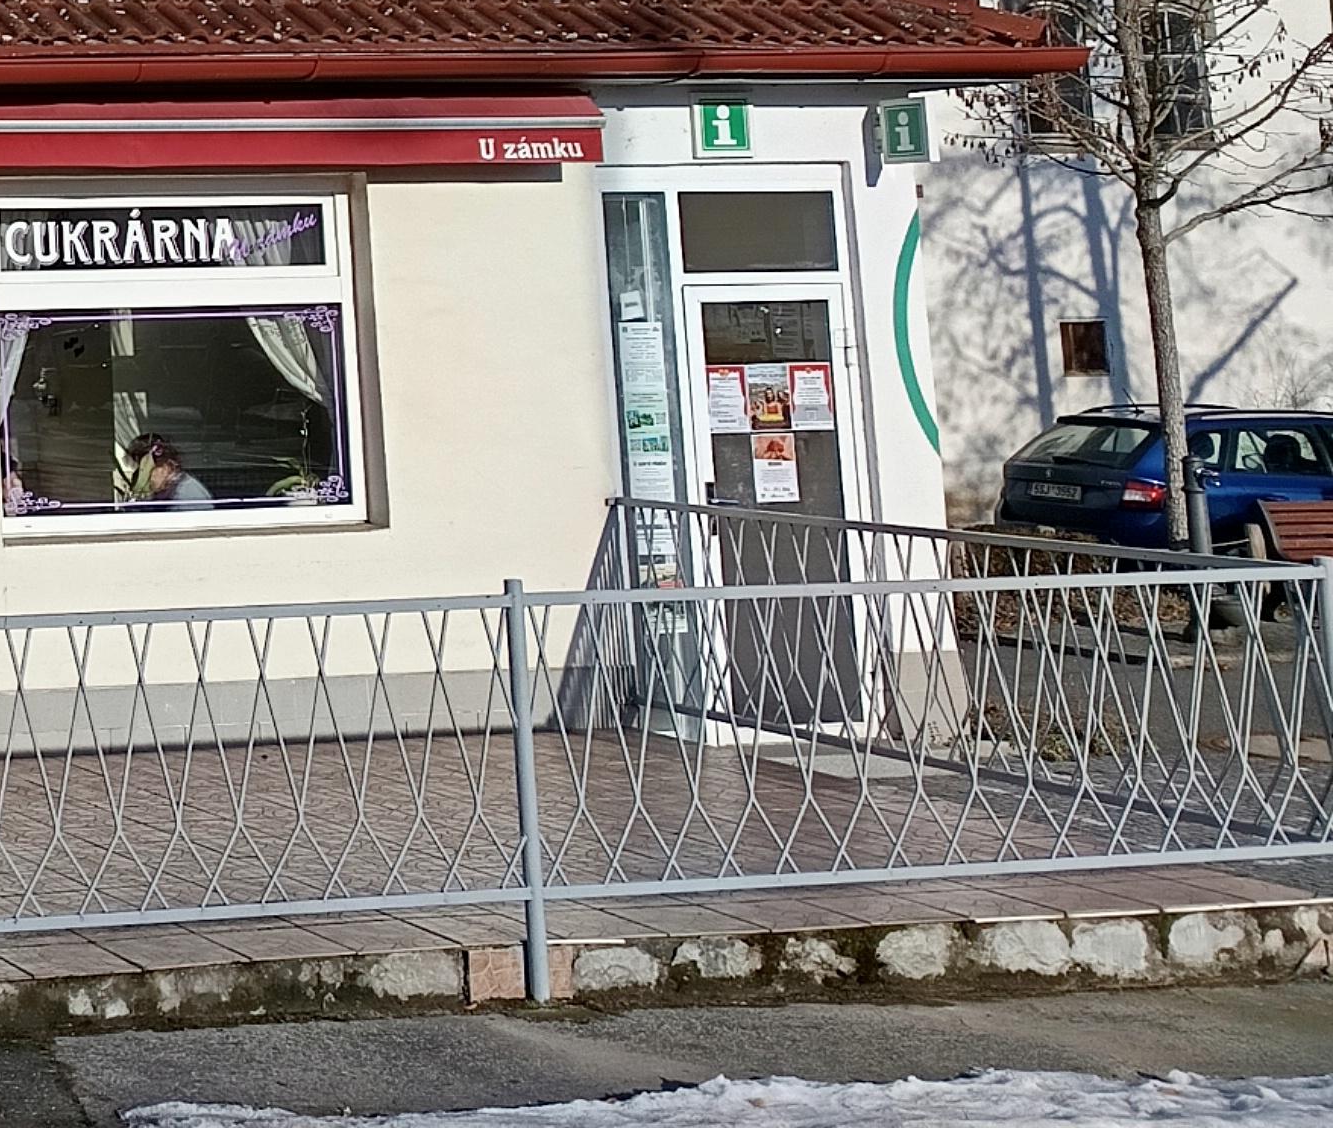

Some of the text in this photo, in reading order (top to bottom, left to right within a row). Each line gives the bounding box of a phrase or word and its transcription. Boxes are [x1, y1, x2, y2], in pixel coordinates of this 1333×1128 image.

[478, 136, 584, 160] U zámku
[3, 208, 233, 267] CUKRÁRNA
